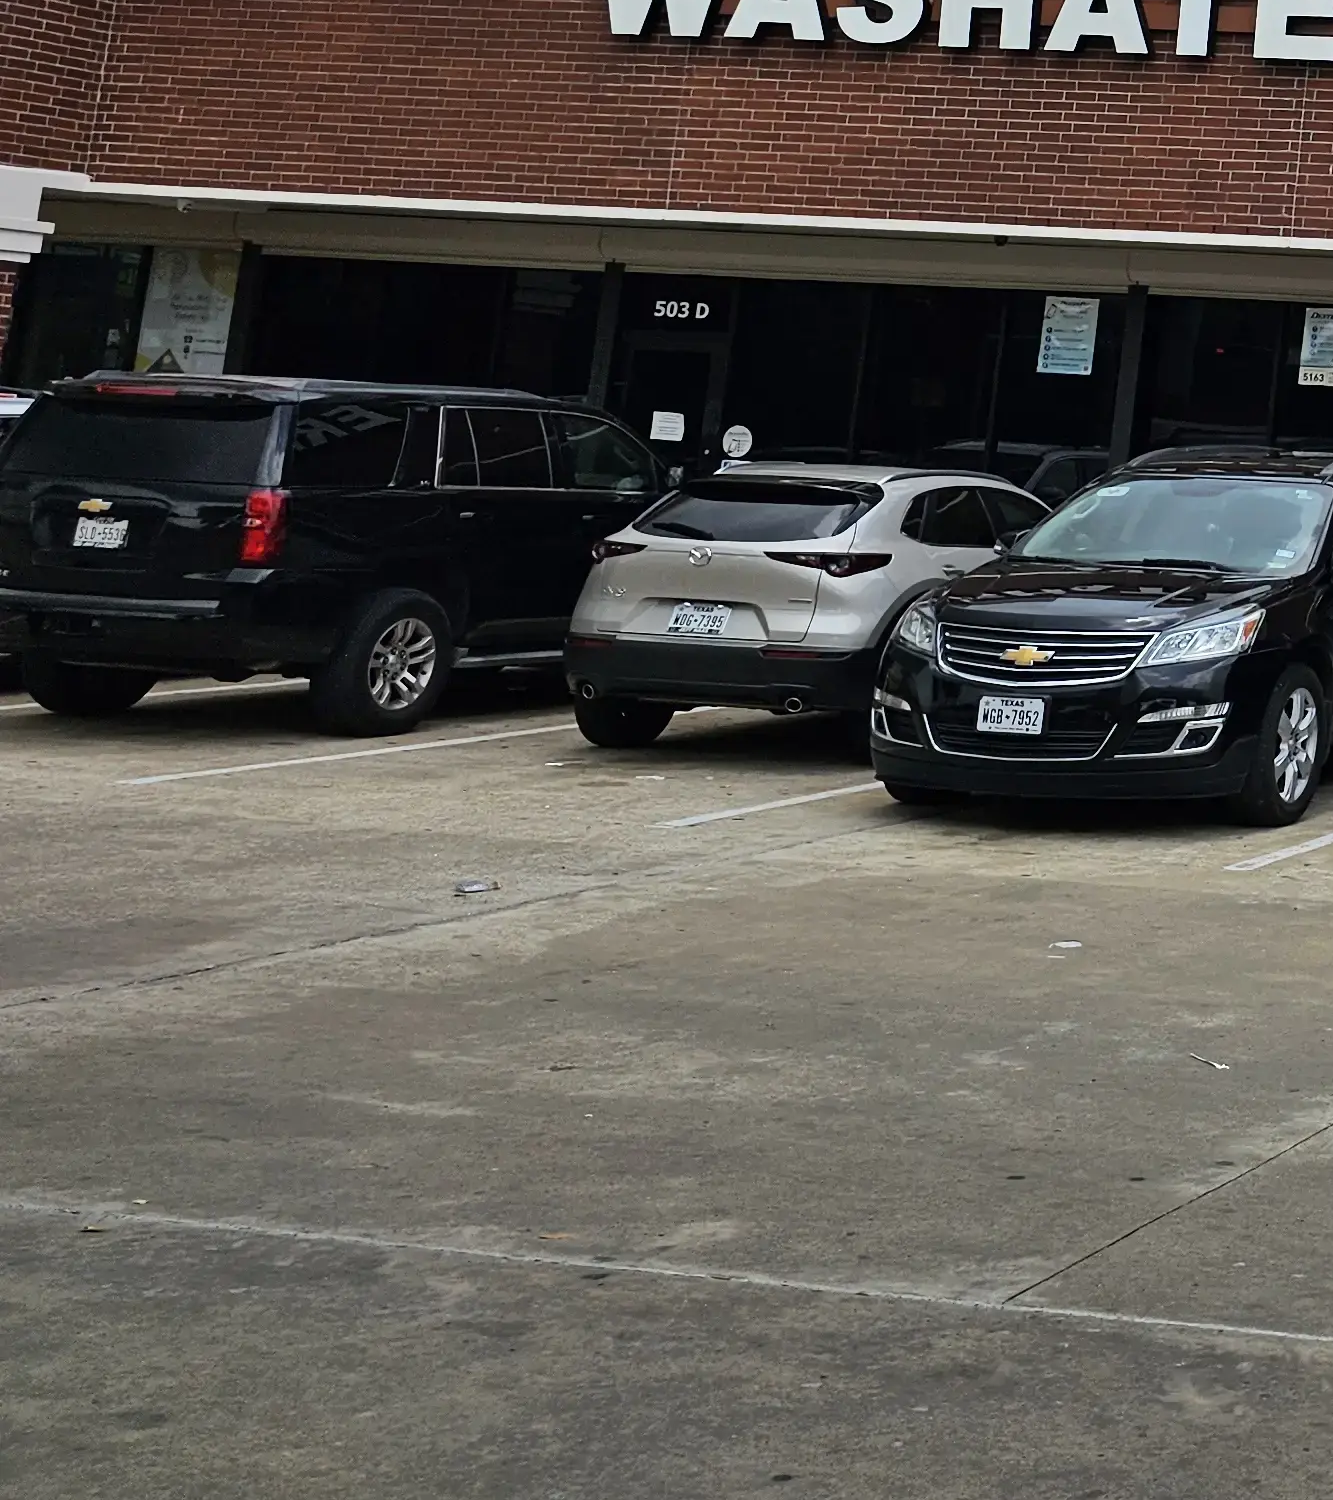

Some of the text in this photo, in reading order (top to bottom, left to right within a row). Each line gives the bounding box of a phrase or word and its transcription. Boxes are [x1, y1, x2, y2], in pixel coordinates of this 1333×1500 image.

[653, 301, 710, 319] 503 D
[1303, 373, 1325, 382] 5163
